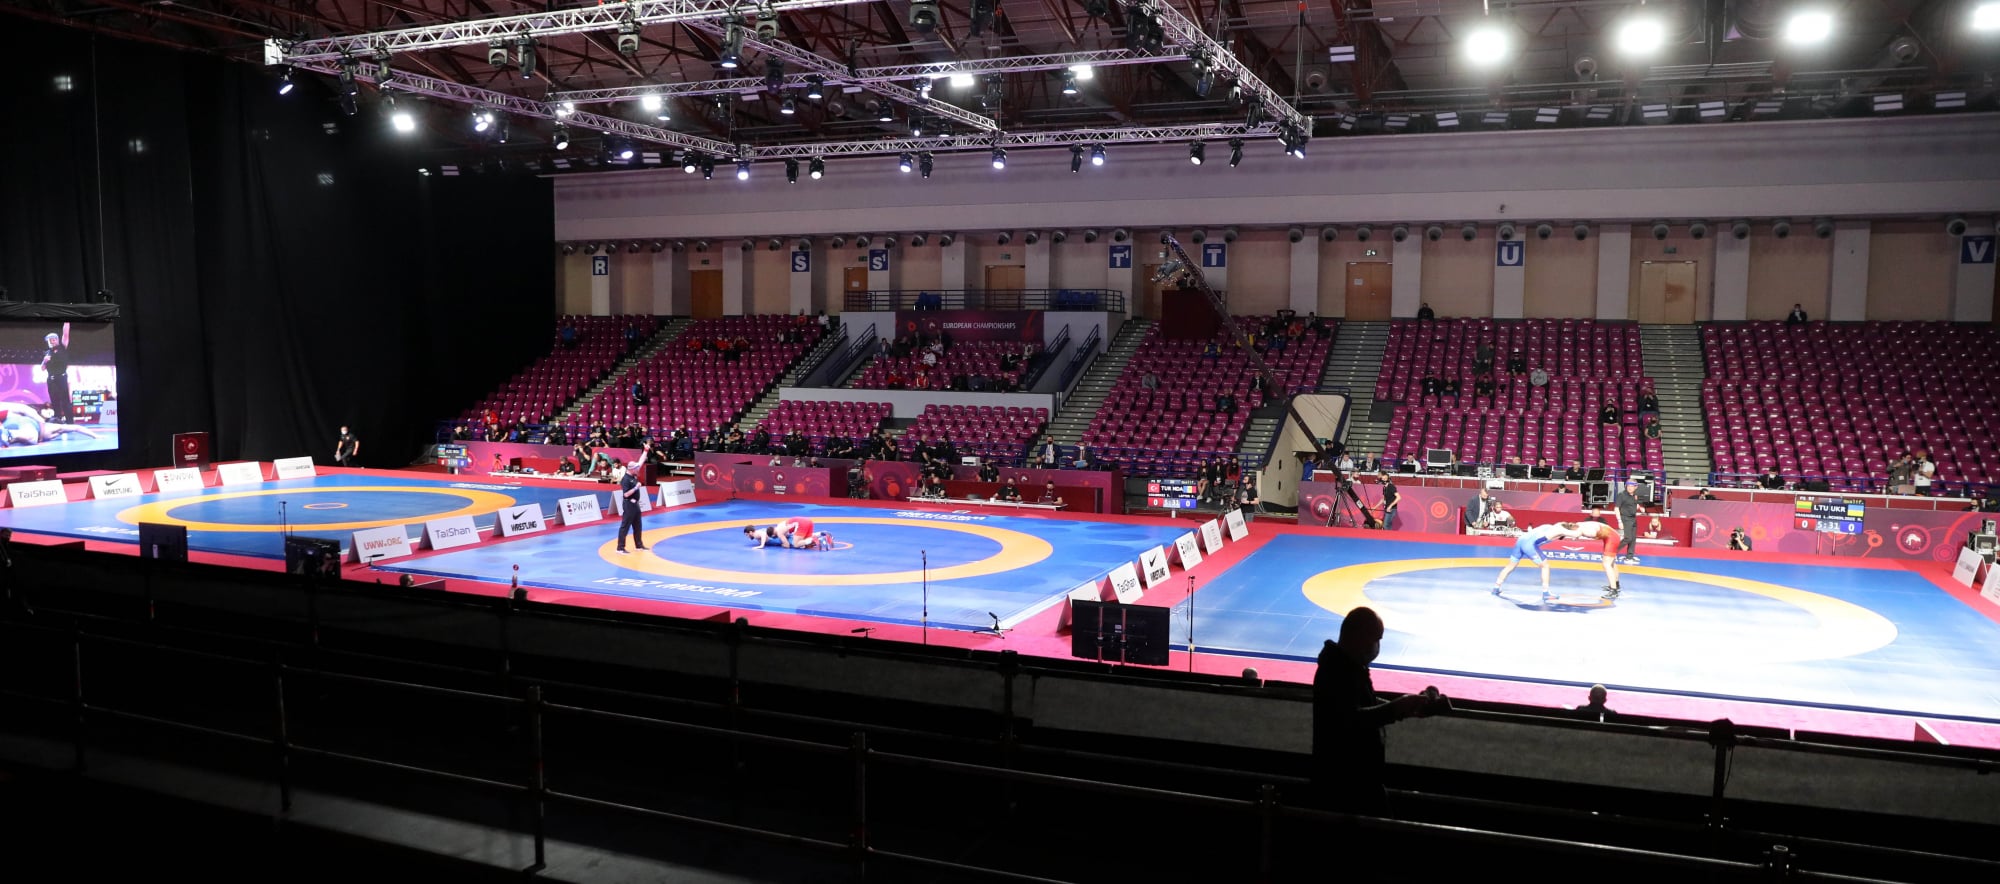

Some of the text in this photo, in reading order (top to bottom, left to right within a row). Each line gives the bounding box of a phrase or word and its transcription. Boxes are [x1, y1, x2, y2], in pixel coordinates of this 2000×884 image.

[1206, 248, 1222, 266] T
[1501, 246, 1519, 265] U
[1967, 241, 1990, 262] V
[595, 260, 606, 275] R
[795, 255, 807, 271] S
[17, 489, 58, 499] TaiShan
[1813, 504, 1846, 513] LTU UKR
[511, 520, 537, 532] WRESTLING
[1801, 520, 1808, 528] 0
[1817, 521, 1840, 530] 5:31
[1848, 523, 1855, 532] 0
[435, 527, 470, 539] TaiShan
[363, 536, 402, 551] UWW.ORG
